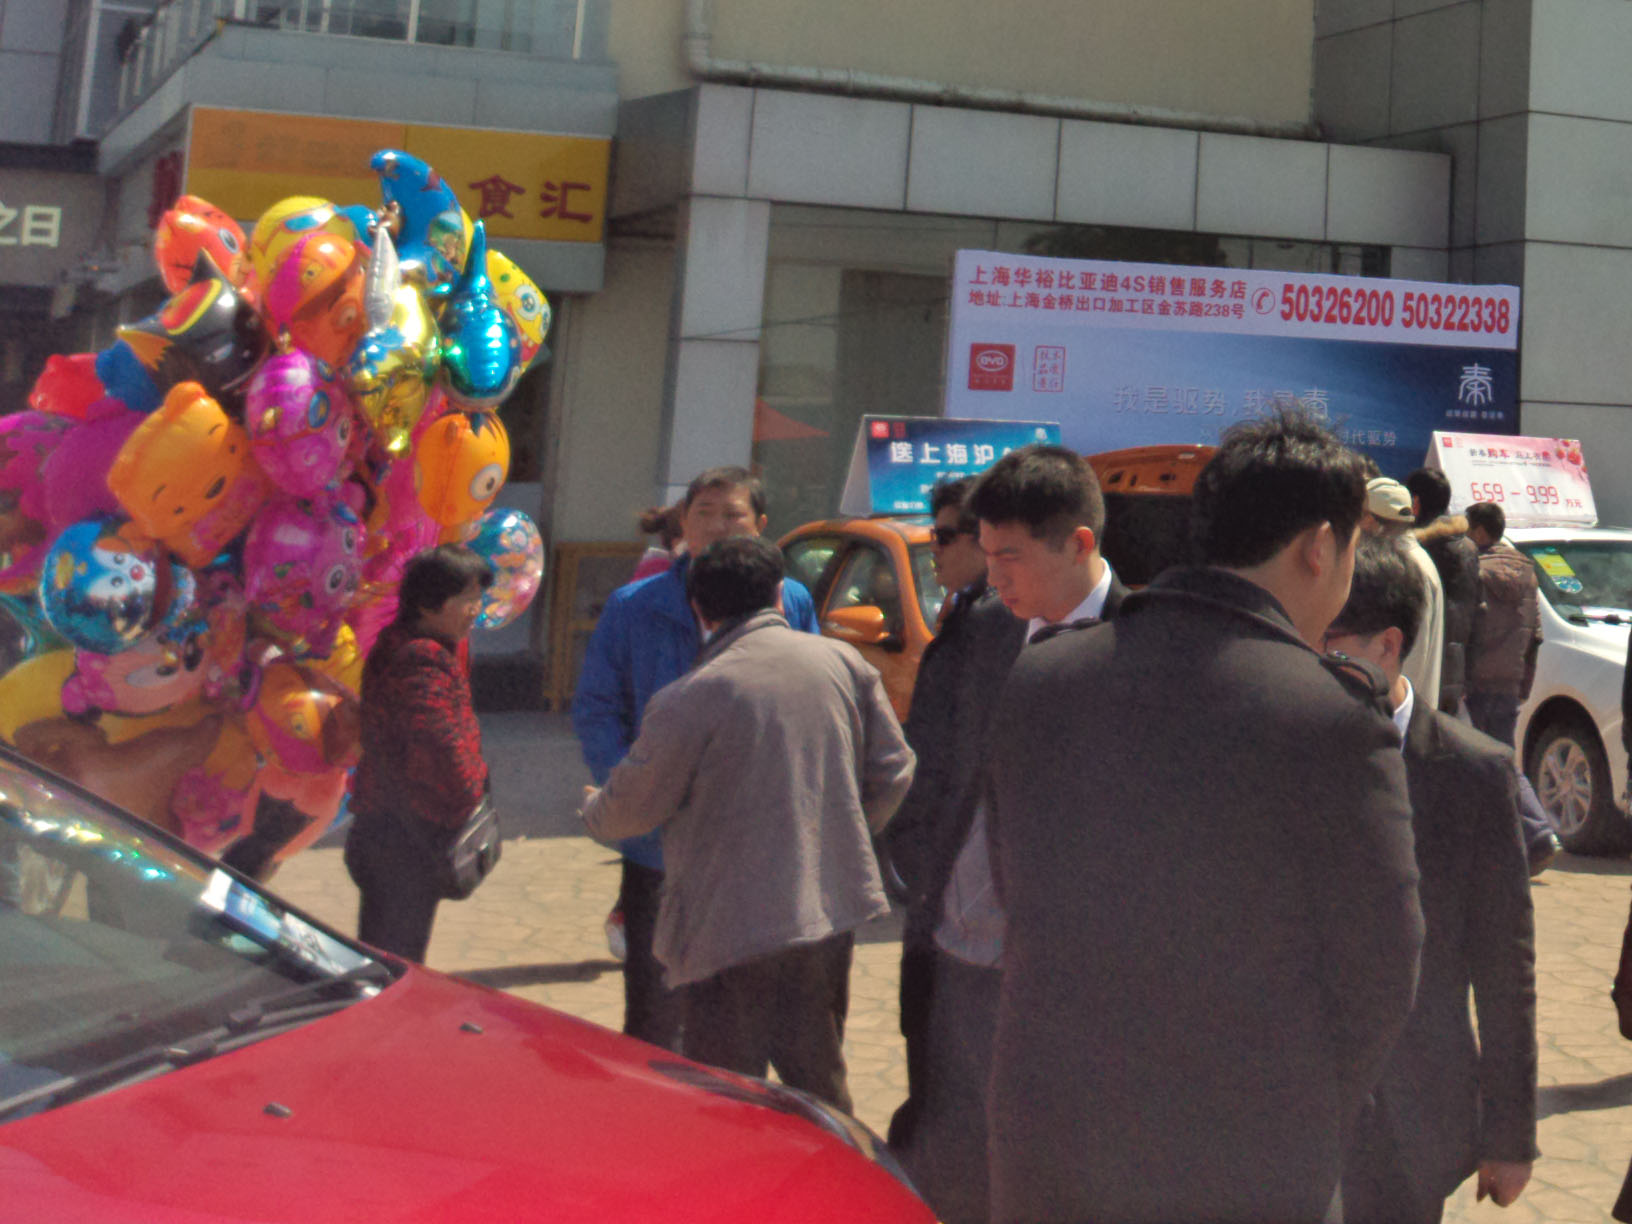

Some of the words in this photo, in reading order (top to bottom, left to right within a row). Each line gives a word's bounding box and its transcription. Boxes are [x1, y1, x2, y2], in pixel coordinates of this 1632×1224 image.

[470, 174, 594, 224] 食汇
[968, 265, 1248, 300] 上海华裕比亚迪4S销售服务店
[1280, 283, 1395, 327] 50326200
[1402, 291, 1511, 334] 50322338
